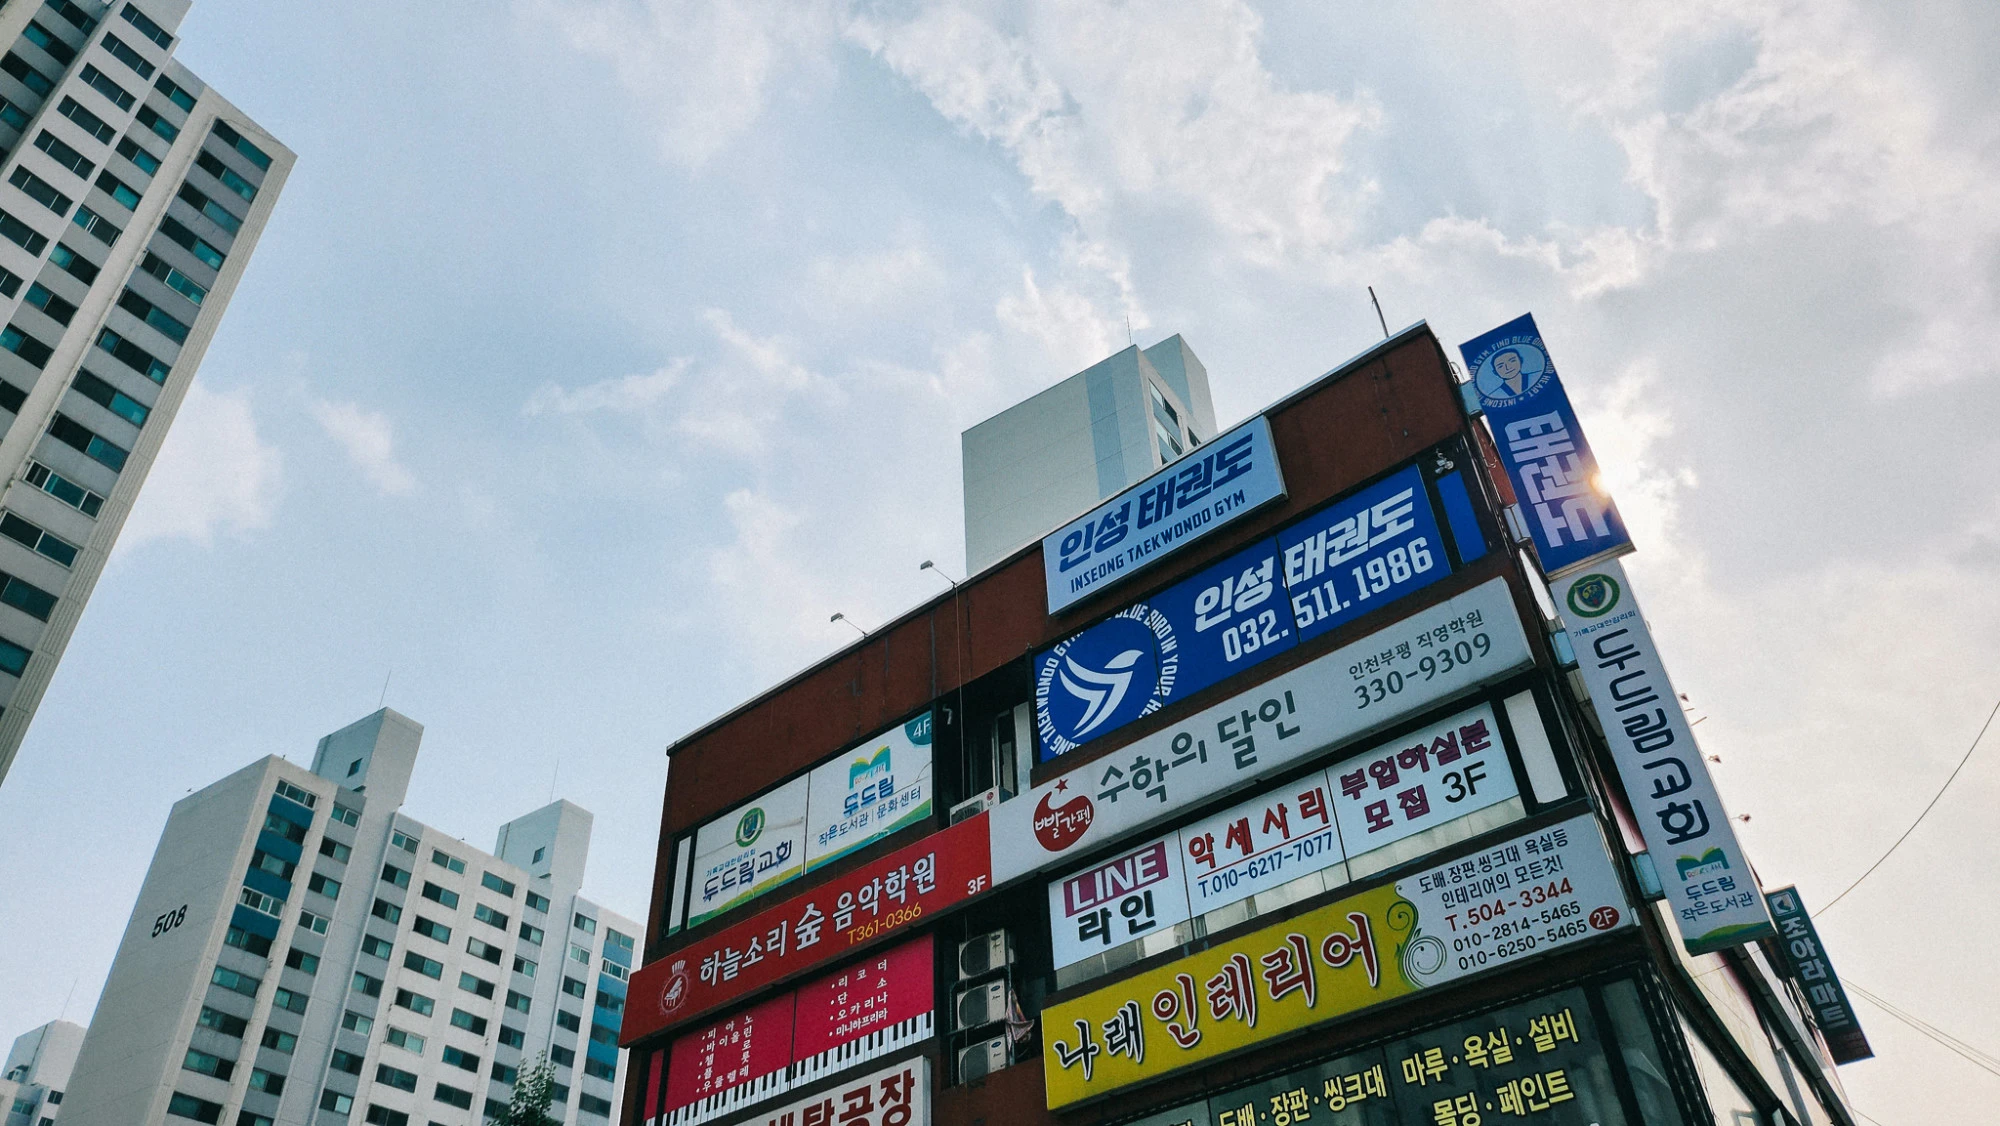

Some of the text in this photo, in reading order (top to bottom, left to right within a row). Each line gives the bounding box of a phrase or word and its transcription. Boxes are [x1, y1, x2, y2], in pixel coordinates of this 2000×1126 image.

[1492, 338, 1510, 351] FIND
[1512, 335, 1533, 344] BLUE
[1482, 398, 1516, 408] INSEONG
[1059, 432, 1253, 573] 인성 태권도
[1505, 410, 1610, 548] 태권도
[1070, 489, 1246, 594] INSEONG TAEKWONDO GYM
[1194, 487, 1415, 633] 인성 태권도
[1352, 536, 1434, 601] 1986
[1144, 609, 1173, 640] BIRD
[1160, 635, 1177, 654] IN
[1349, 609, 1484, 681] 인천부평 직영학원
[1153, 654, 1178, 697] YOUR
[1354, 632, 1491, 710] 330-9309
[913, 718, 931, 737] 4F
[1036, 657, 1059, 744] TAEKWONDO
[1097, 690, 1300, 803] 수학의 달인
[1339, 718, 1492, 801] 부업하실분
[1592, 628, 1710, 845] 두드림교회
[818, 785, 921, 846] 작은도서관 문화센터
[843, 775, 894, 816] 두드림
[1034, 804, 1092, 839] 빨간펜
[1363, 760, 1488, 834] 모집 3F
[1188, 786, 1329, 869] 악세사리
[1525, 828, 1569, 855] 욕실등
[703, 840, 792, 902] 두드림교회
[832, 852, 936, 933] 음악학원
[967, 874, 986, 895] 3F
[1071, 847, 1159, 908] LINE
[1198, 831, 1333, 899] T.010-6217-7077
[1441, 854, 1563, 909] 인테리어의 모든것!
[1685, 875, 1736, 902] 두드림
[152, 904, 188, 938] 508
[848, 901, 923, 945] T361-0366
[1077, 889, 1157, 946] 라인
[1445, 877, 1574, 932] T.504-3344
[1453, 901, 1581, 952] 010-2814-5465
[1592, 909, 1614, 928] 2F
[1680, 892, 1754, 922] 작은도서관
[1458, 919, 1588, 970] 010-6250-5465
[837, 991, 888, 1020] 오카리나
[706, 1025, 752, 1052] 바이올린
[1401, 1008, 1579, 1086] 마루 욕실 설비
[1270, 1087, 1310, 1126] 장판
[1324, 1064, 1387, 1112] 씽크대
[1496, 1069, 1574, 1116] 페인트
